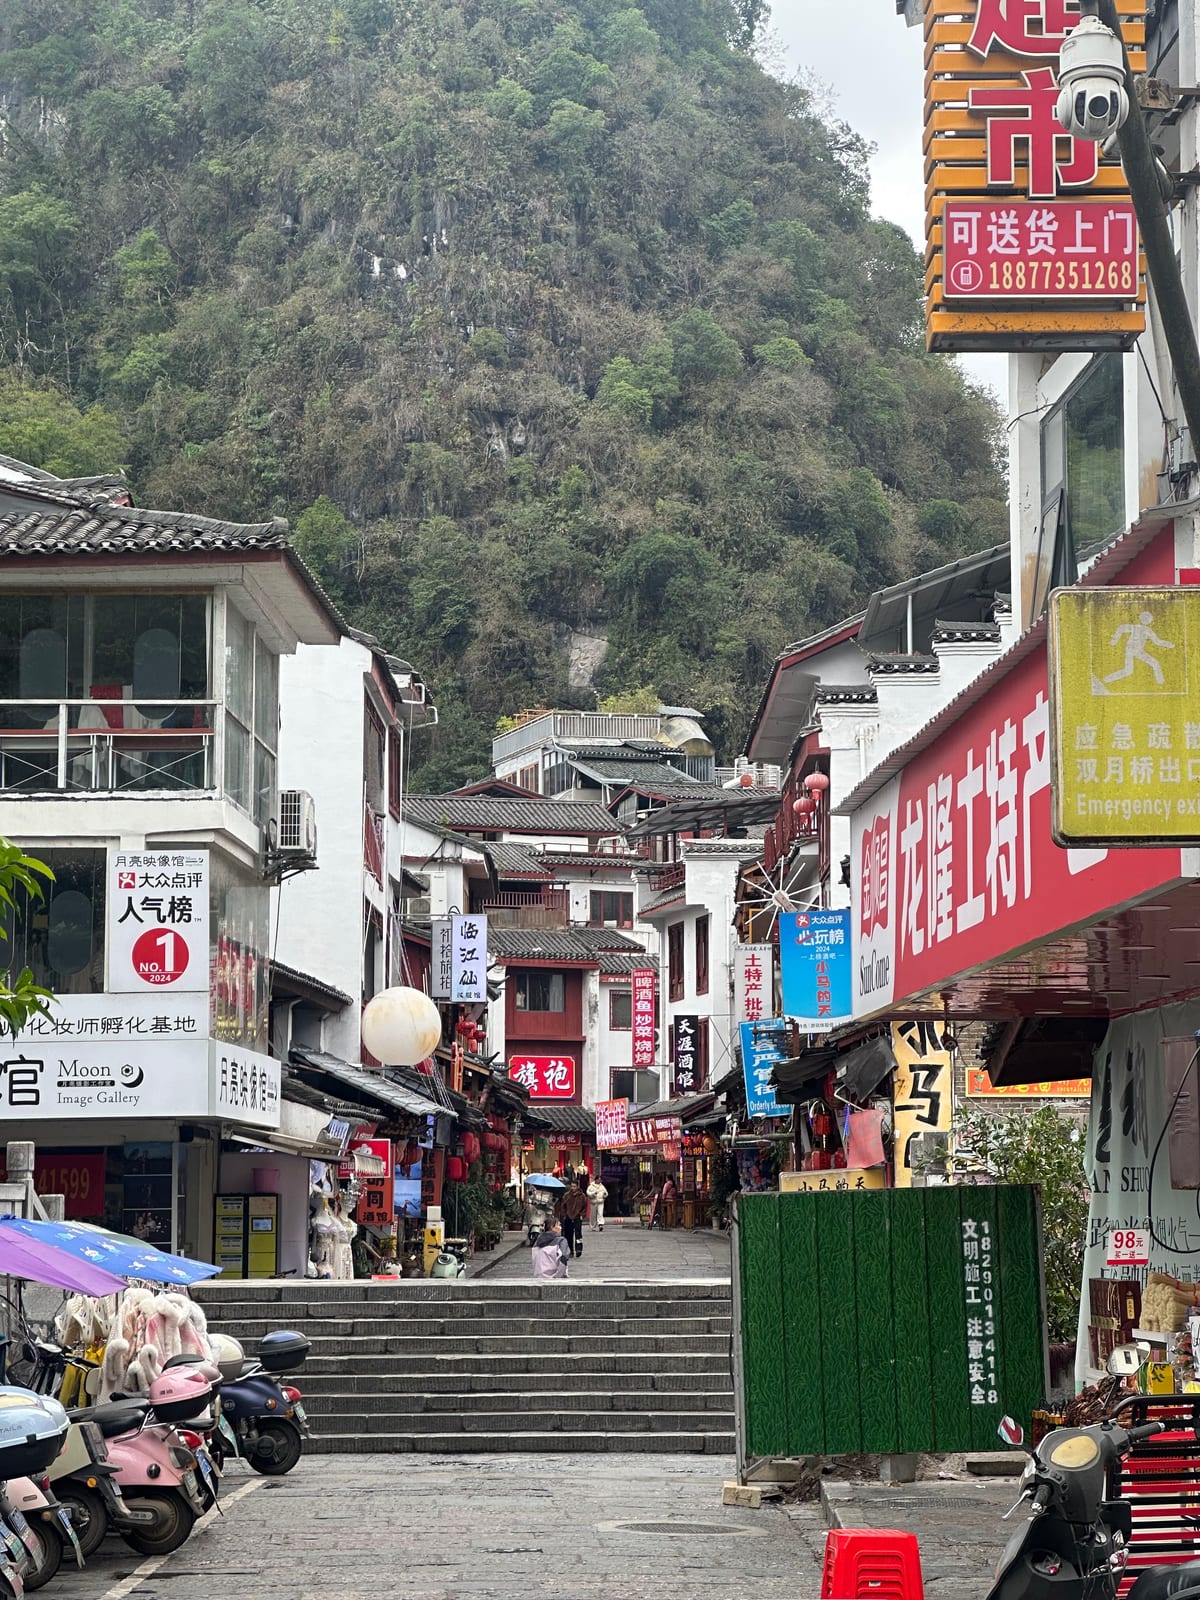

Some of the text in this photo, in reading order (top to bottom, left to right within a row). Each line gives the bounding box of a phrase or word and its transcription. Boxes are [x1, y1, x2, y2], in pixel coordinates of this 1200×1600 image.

[949, 208, 1133, 255] 可送货上门
[989, 260, 1132, 290] 18877351268
[1076, 794, 1200, 821] Emergency exi
[901, 690, 1050, 957] 龙隆土特产
[115, 855, 185, 867] 月亮映像馆
[138, 872, 203, 888] 大众点评
[118, 896, 193, 923] 人气榜
[811, 915, 842, 925] 大众点评
[796, 929, 844, 946] 必玩榜
[459, 921, 480, 985] 临江仙
[150, 974, 171, 983] 2024
[859, 949, 890, 996] SunCome
[816, 960, 831, 1017] 小马的天
[677, 1018, 696, 1088] 天涯酒馆
[57, 1059, 112, 1078] Moon
[513, 1060, 571, 1091] 旗袍
[57, 1091, 140, 1107] Image Gallery
[219, 1057, 267, 1112] 月亮映像馆
[895, 1021, 943, 1168] 小马
[750, 1101, 770, 1112] Orderly
[1114, 1251, 1144, 1259] 买一送一
[962, 1218, 986, 1405] 文明施工 注意安全
[980, 1221, 998, 1404] 18290134118
